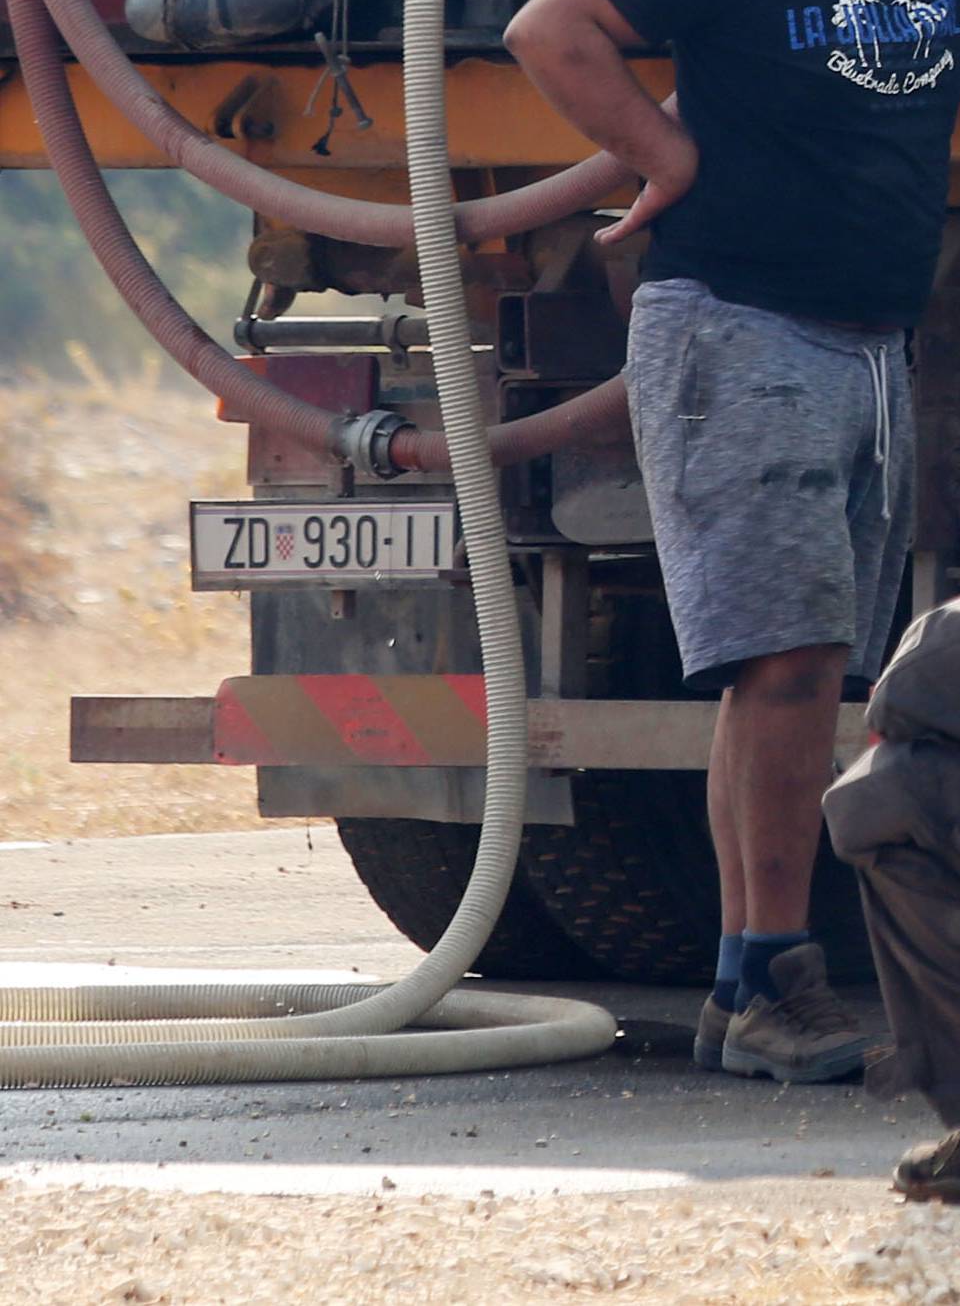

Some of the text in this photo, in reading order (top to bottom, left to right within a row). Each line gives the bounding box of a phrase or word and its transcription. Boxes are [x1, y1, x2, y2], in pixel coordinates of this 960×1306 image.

[787, 6, 827, 51] LA
[836, 2, 918, 44] JOLLA
[826, 48, 954, 95] Bluetrade Company
[223, 517, 270, 569] ZD
